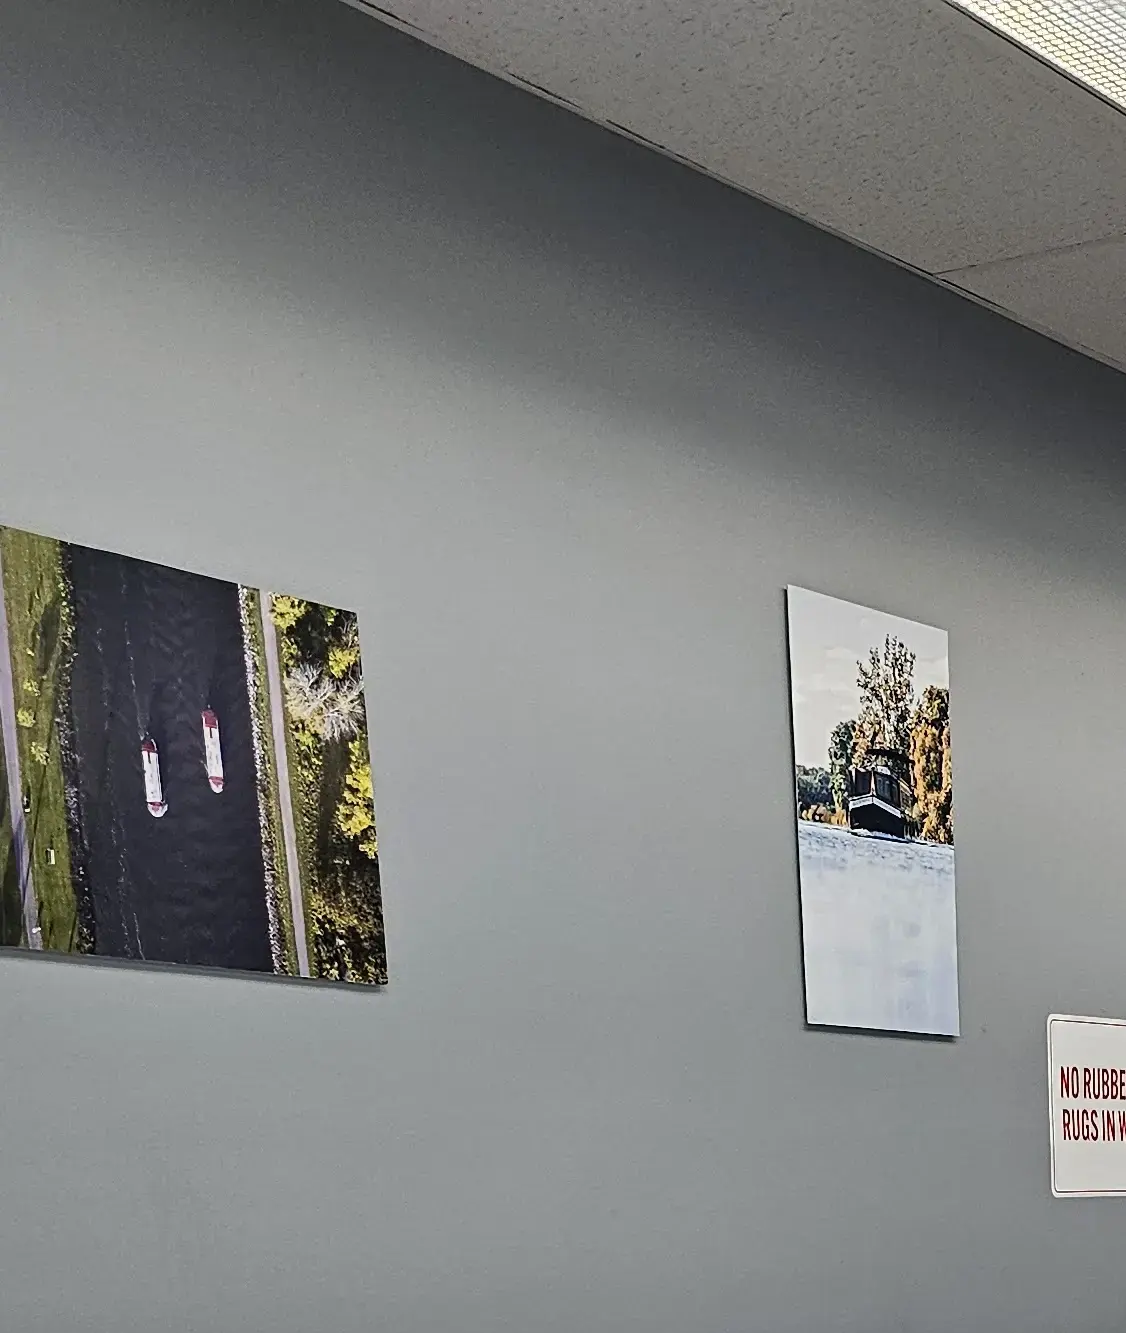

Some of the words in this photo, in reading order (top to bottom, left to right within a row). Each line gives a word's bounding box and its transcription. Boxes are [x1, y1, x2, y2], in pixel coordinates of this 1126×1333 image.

[1060, 1066, 1079, 1099] NO
[1062, 1108, 1098, 1141] RUGS
[1102, 1110, 1116, 1141] IN
